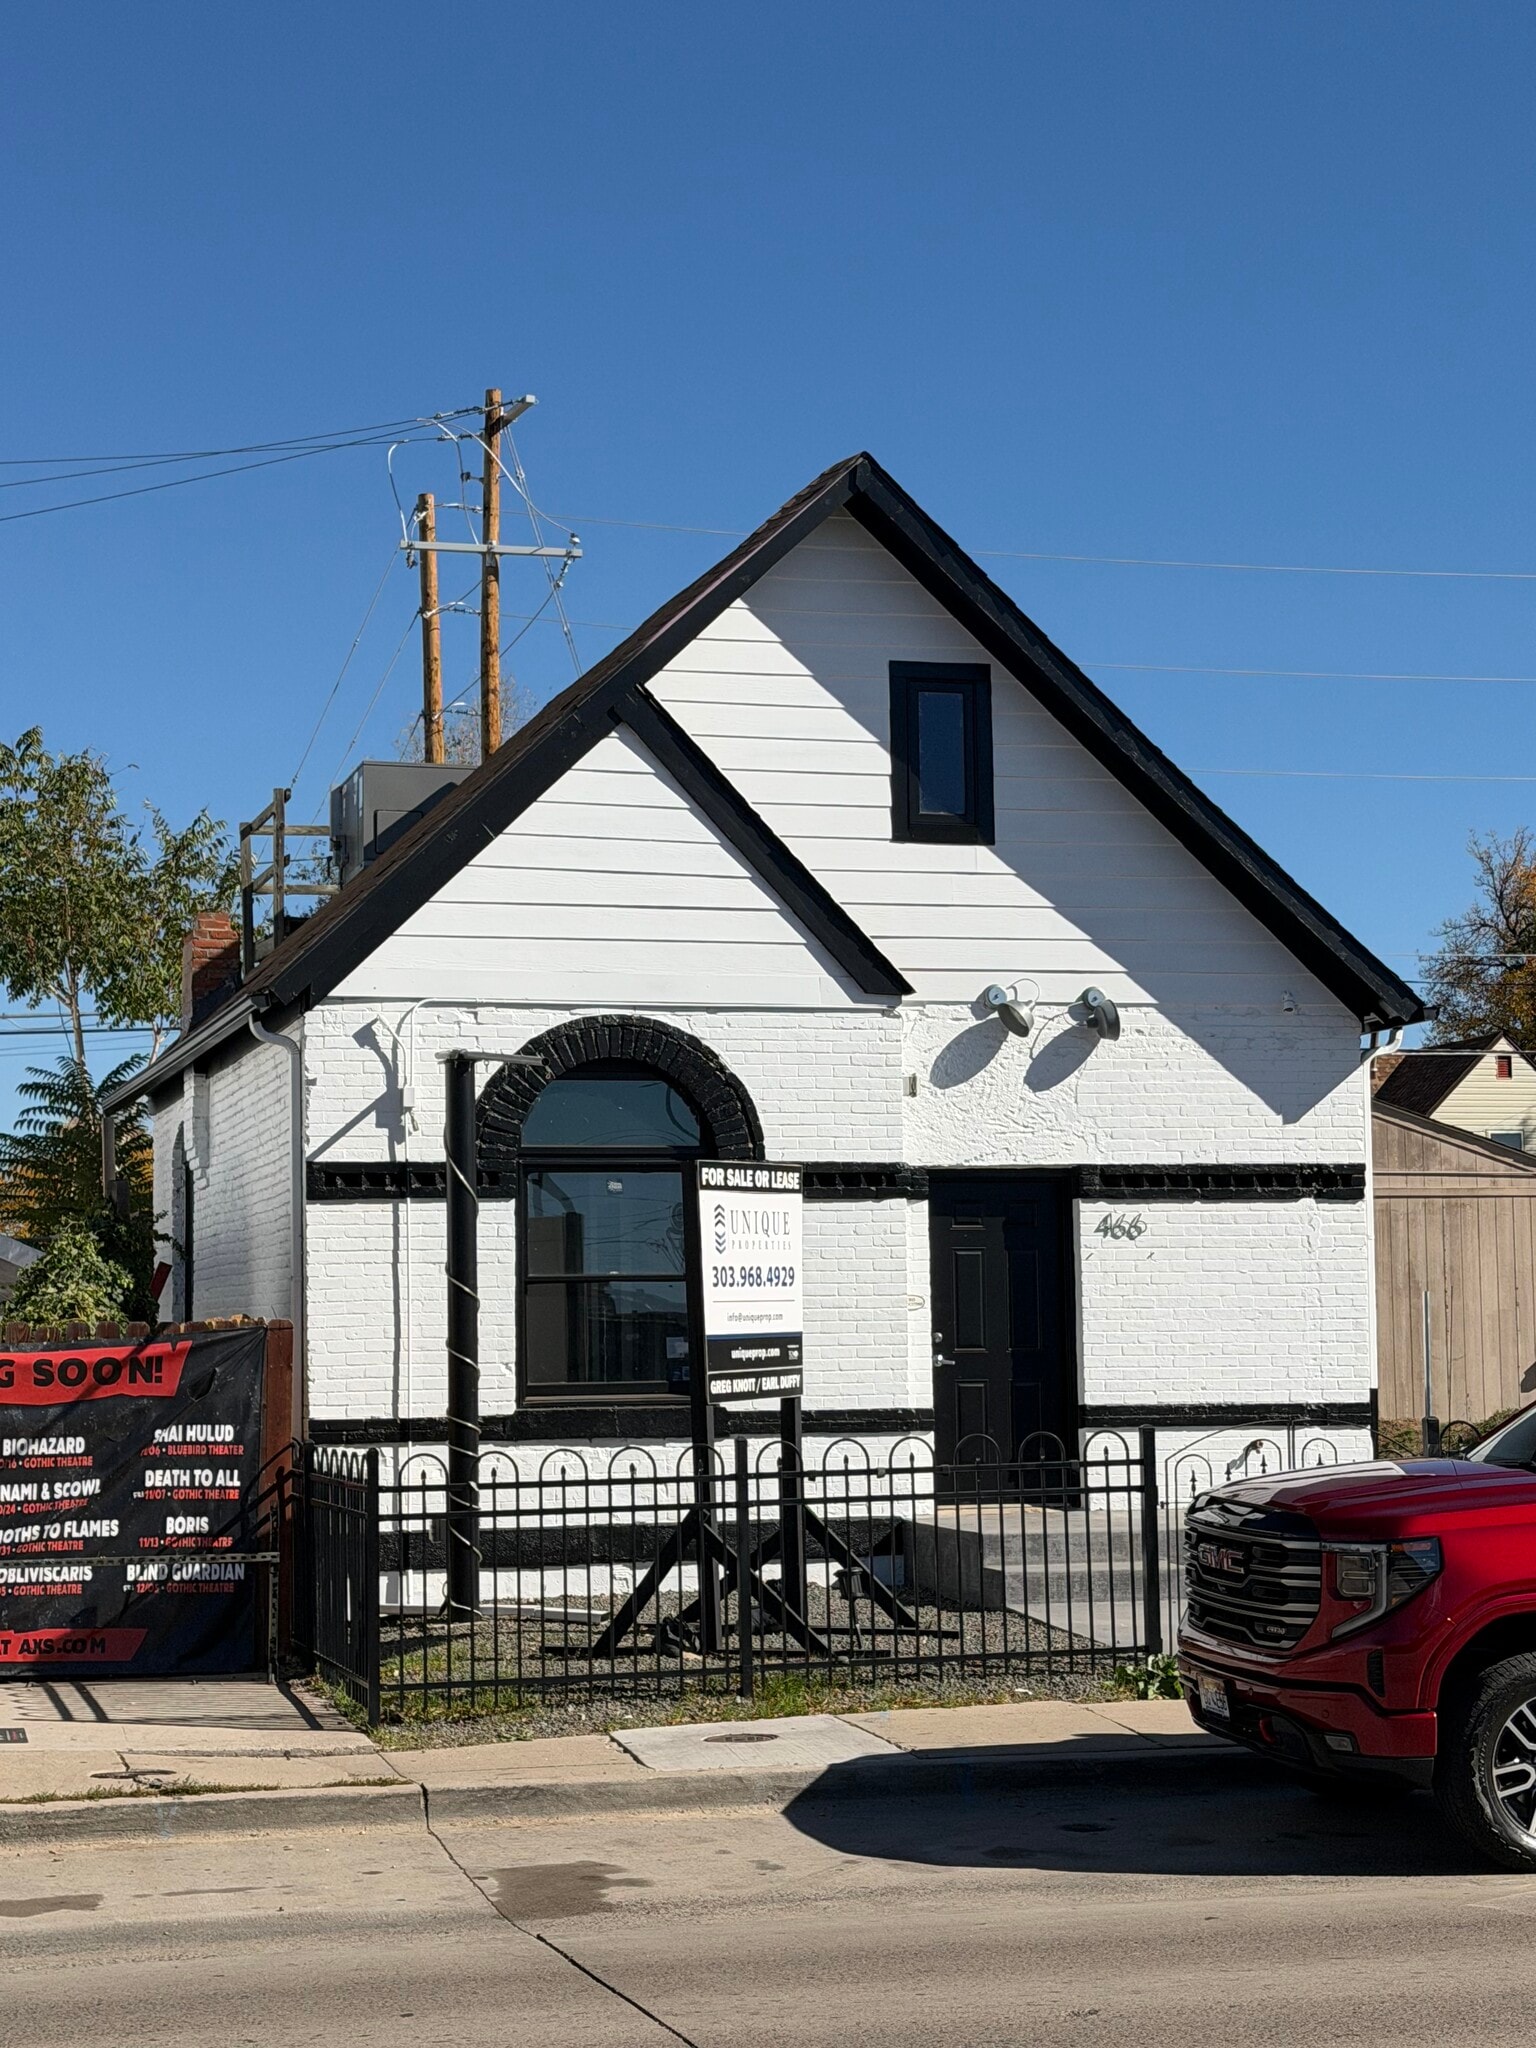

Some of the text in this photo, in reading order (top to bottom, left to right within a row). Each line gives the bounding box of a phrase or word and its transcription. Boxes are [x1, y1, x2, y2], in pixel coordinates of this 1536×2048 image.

[701, 1167, 800, 1190] FOR SALE OR LEASE
[730, 1209, 791, 1238] UNIQUE
[1093, 1212, 1147, 1240] 466
[731, 1239, 792, 1251] PROPERTIES
[711, 1265, 796, 1288] 303.968.4929
[726, 1312, 784, 1324] info@uniqueprop.com
[730, 1346, 781, 1362] uniqueprop.com
[32, 1355, 164, 1387] SOON!
[710, 1379, 732, 1395] GREG
[732, 1377, 756, 1393] KNOTT
[761, 1375, 780, 1391] EARL
[780, 1374, 801, 1389] DUFFY
[152, 1424, 235, 1444] SHAI HULUD
[2, 1436, 86, 1456] BIOHAZARD
[167, 1444, 207, 1456] BLUEBIRD
[207, 1444, 245, 1456] THEATER
[23, 1457, 55, 1469] GOTHIC
[56, 1456, 94, 1467] THEATRE
[144, 1469, 241, 1487] DEATH TO ALL
[41, 1482, 51, 1500] &
[53, 1478, 102, 1499] SCOWL
[172, 1489, 205, 1500] GOTHIC
[204, 1489, 240, 1500] THEATRE
[22, 1502, 54, 1514] GOTHIC
[54, 1498, 90, 1511] THEATRE
[42, 1522, 61, 1539] TO
[63, 1519, 120, 1538] FLAMES
[165, 1516, 210, 1534] BORIS
[16, 1541, 46, 1553] GOTHIC
[47, 1540, 84, 1551] THEATRE
[138, 1537, 160, 1548] 11/13
[1198, 1543, 1245, 1574] GMC
[126, 1563, 245, 1582] BLIND GUARDIAN
[13, 1584, 45, 1596] GOTHIC
[46, 1584, 83, 1595] THEATRE
[166, 1583, 197, 1593] GOTHIC
[198, 1583, 235, 1593] THEATRE
[0, 1637, 106, 1655] T AXS.COM
